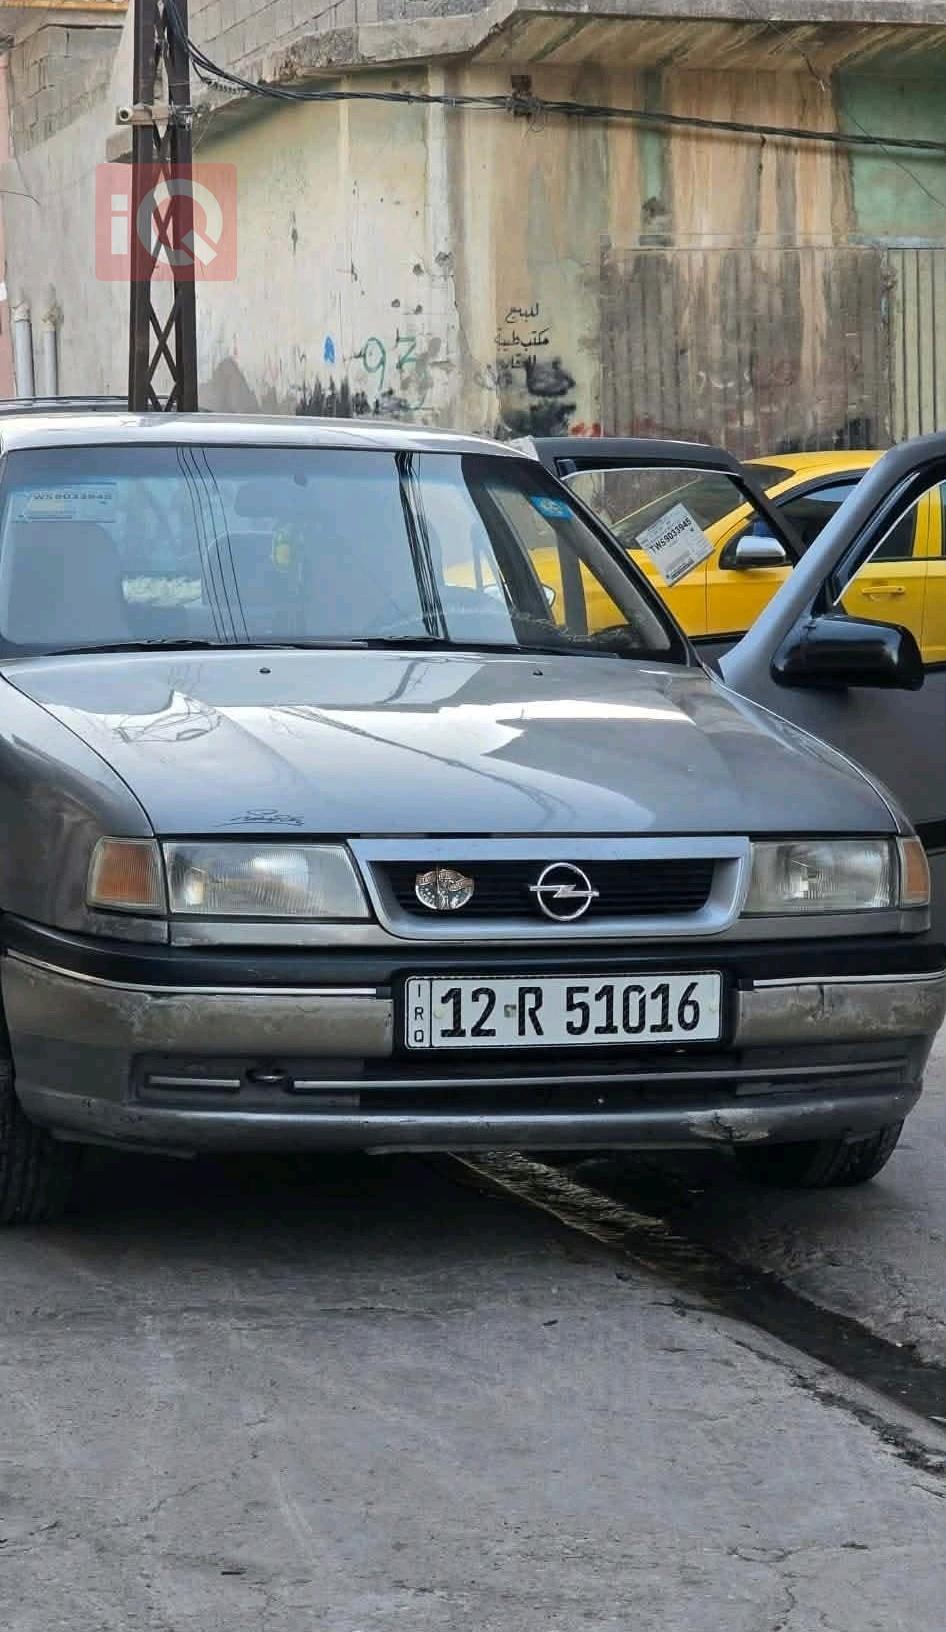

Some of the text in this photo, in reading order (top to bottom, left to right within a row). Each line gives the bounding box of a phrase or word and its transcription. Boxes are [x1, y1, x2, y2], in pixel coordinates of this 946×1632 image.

[520, 326, 551, 352] مكتب
[649, 516, 693, 554] TWS9033945
[440, 982, 701, 1038] 12 R 51016
